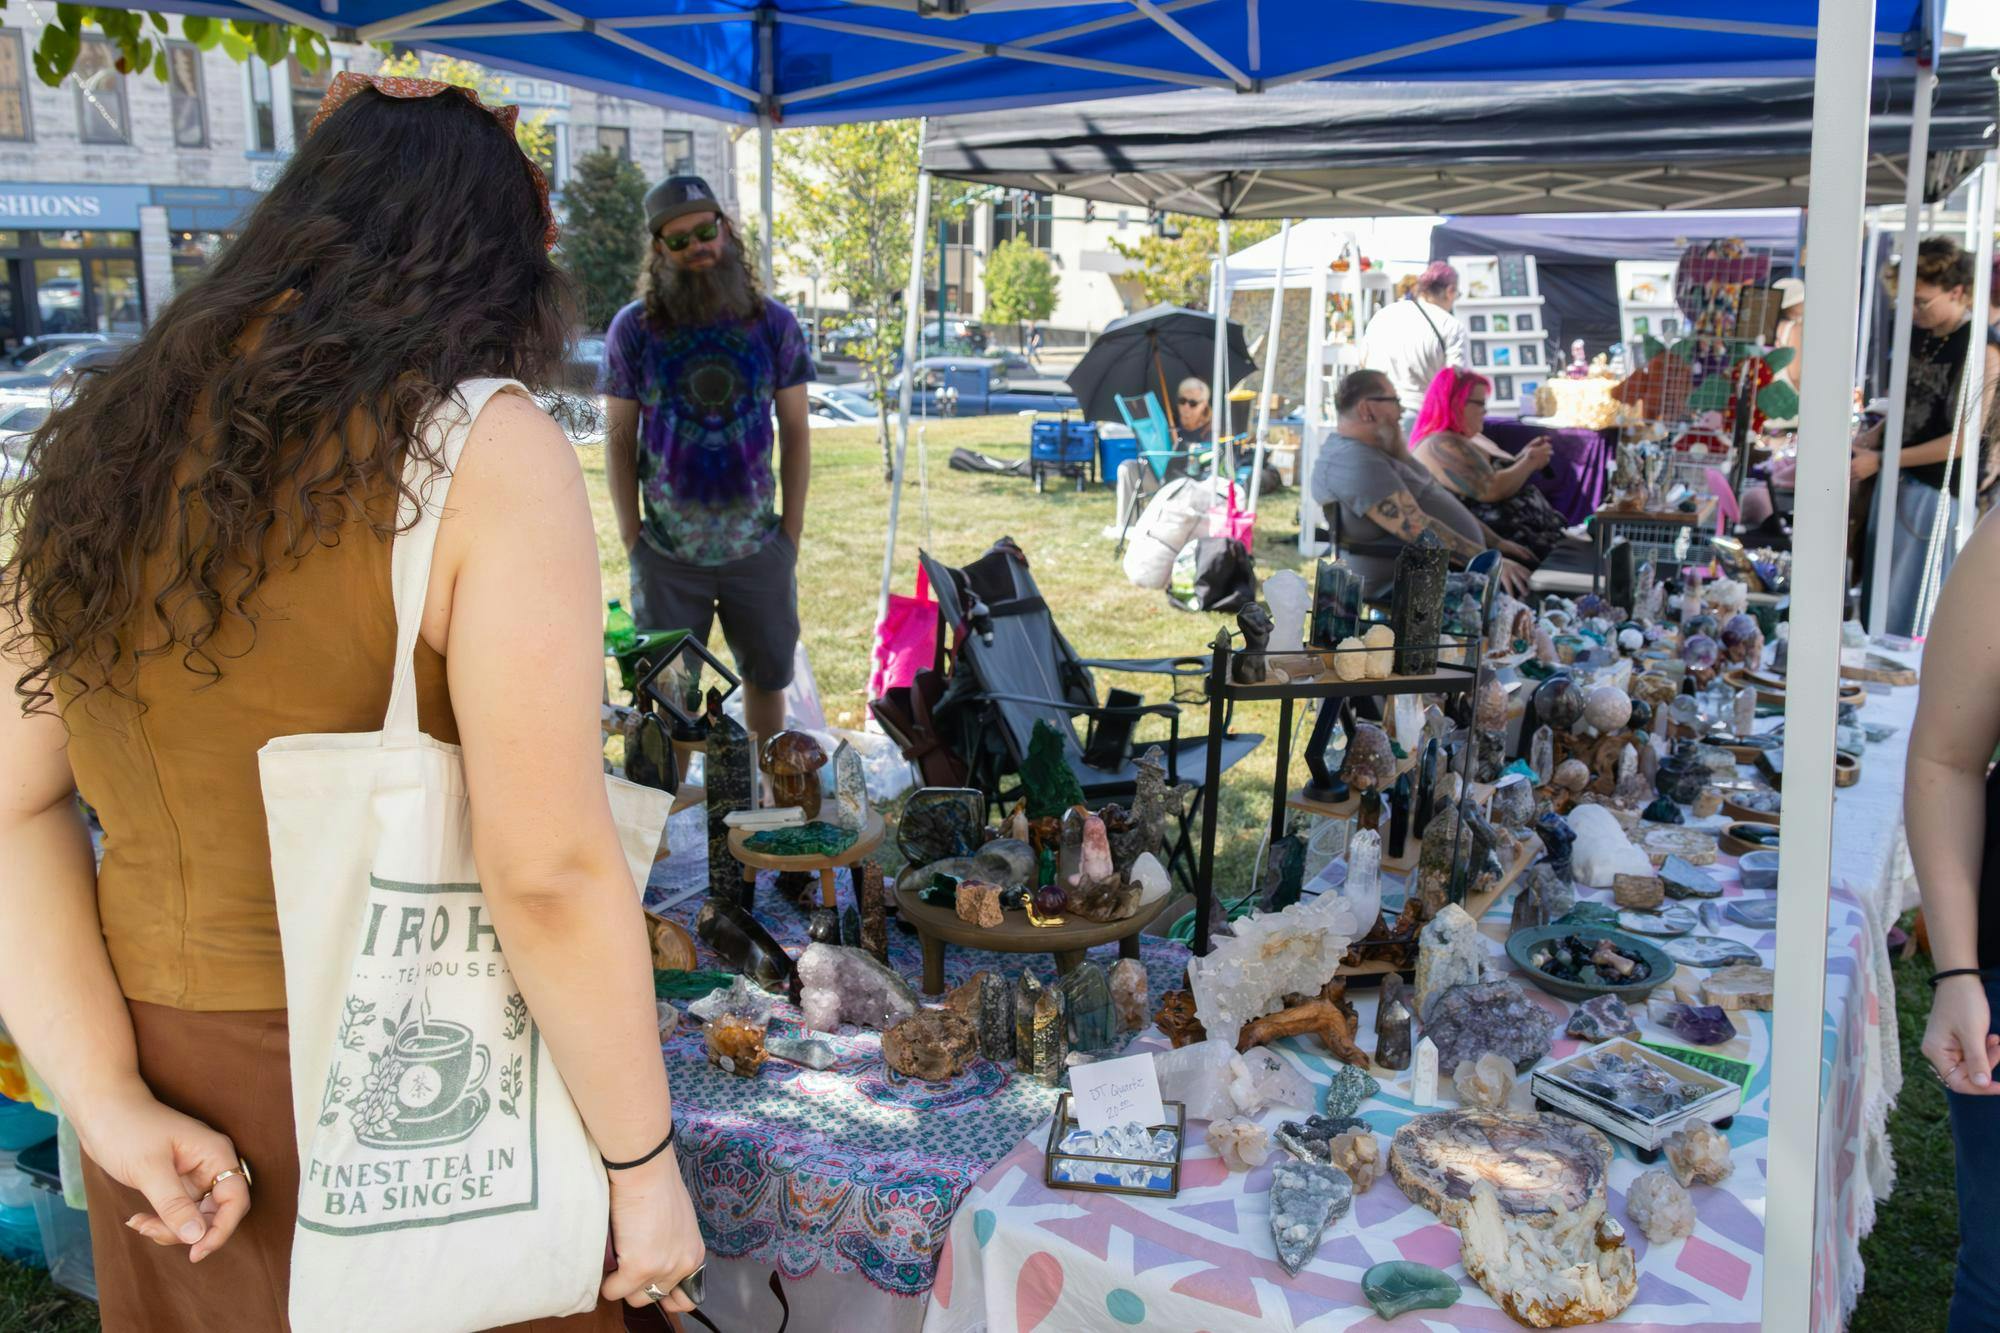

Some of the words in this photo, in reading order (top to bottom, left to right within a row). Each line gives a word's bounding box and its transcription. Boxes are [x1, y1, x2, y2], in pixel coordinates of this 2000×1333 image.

[361, 902, 503, 957] IROH
[425, 961, 497, 977] HOUSE
[308, 1158, 411, 1189] FINEST
[423, 1153, 472, 1180] TEA
[487, 1146, 515, 1172] IN
[324, 1190, 368, 1216] BA
[382, 1183, 451, 1211] SING
[461, 1175, 493, 1201] SE
